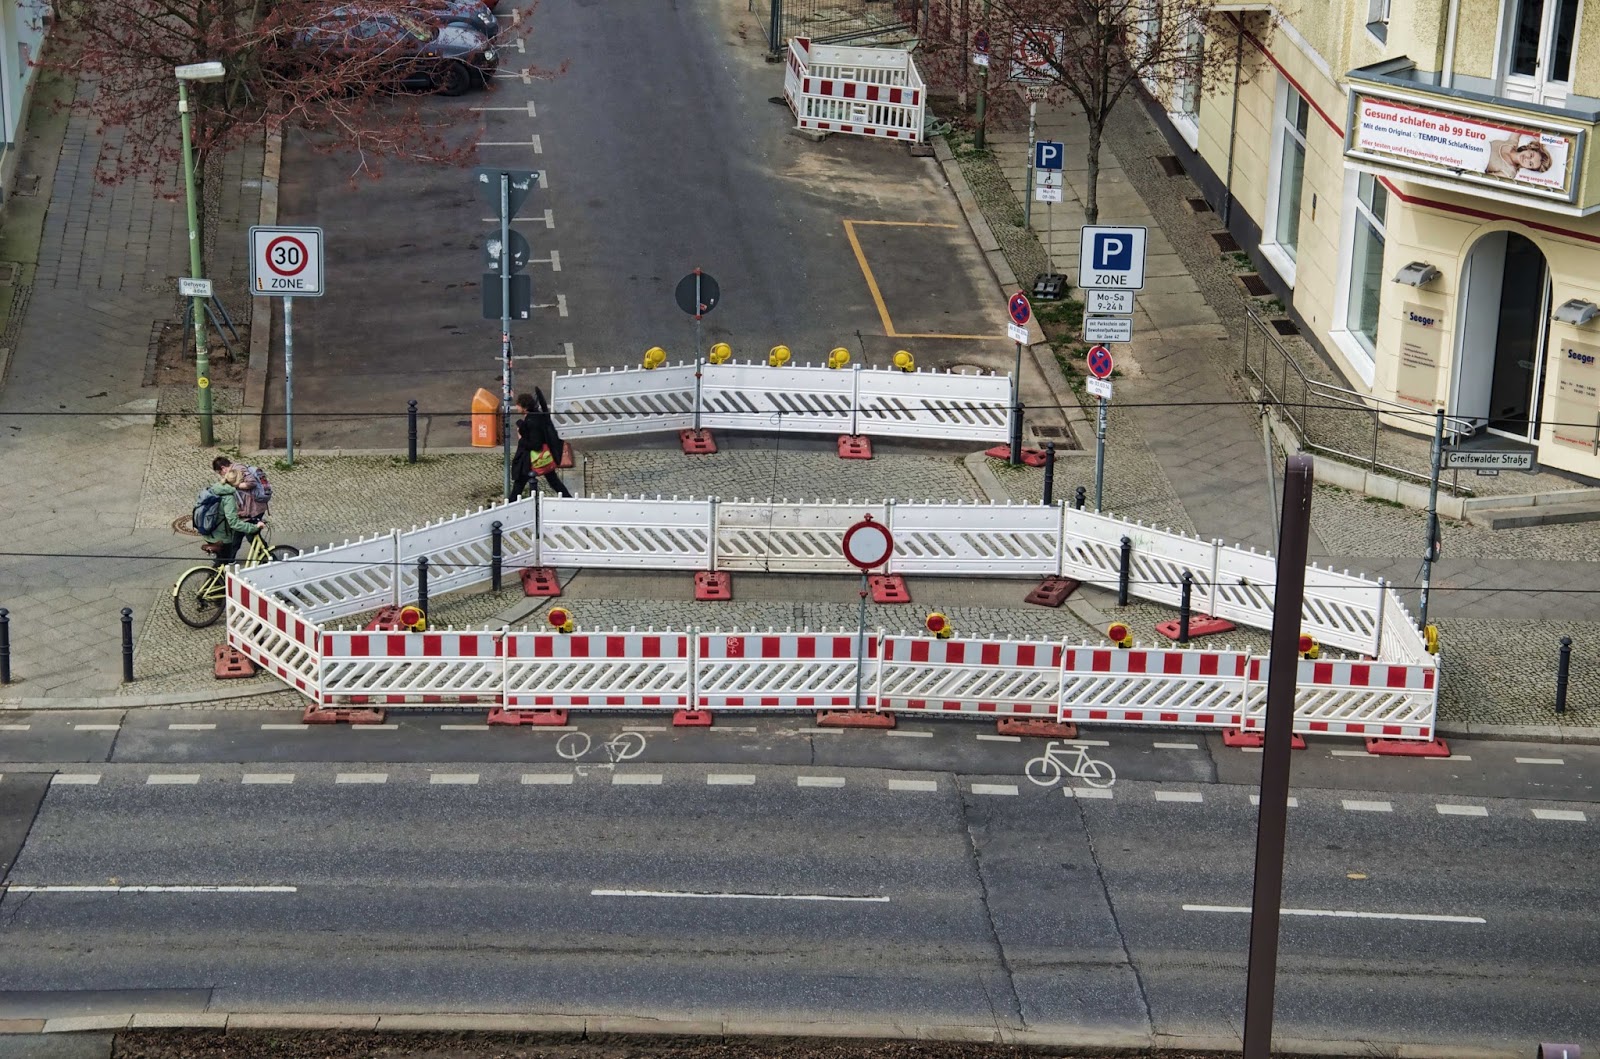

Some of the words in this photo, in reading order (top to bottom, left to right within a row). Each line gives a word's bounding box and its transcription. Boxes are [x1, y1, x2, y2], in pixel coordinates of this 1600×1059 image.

[1364, 108, 1397, 121] Gesund
[1400, 114, 1437, 130] schlafen
[1438, 124, 1451, 132] ab
[1452, 127, 1463, 136] 99
[1465, 128, 1486, 140] Euro
[1363, 122, 1373, 130] Mit
[1375, 124, 1387, 132] dem
[1388, 127, 1412, 138] Original
[1418, 132, 1447, 145] TEMPUR
[1448, 140, 1484, 153] Schlafkissen
[1042, 145, 1057, 166] P
[1361, 138, 1373, 146] Hier
[1374, 141, 1391, 150] testen
[1392, 144, 1403, 152] und
[1403, 147, 1438, 161] Entspannung
[1440, 156, 1463, 166] erleben!
[274, 246, 299, 265] 30
[1102, 238, 1123, 265] P
[183, 280, 208, 289] Gehweg-
[271, 278, 303, 289] ZONE
[1095, 274, 1127, 285] ZONE
[1097, 293, 1125, 301] Mo-Sa
[1097, 302, 1117, 311] 9-24
[1118, 303, 1123, 311] h
[1409, 311, 1435, 326] Seeger
[1567, 348, 1595, 364] Seeger
[1450, 453, 1500, 463] Greifswalder
[1502, 454, 1528, 466] Straße
